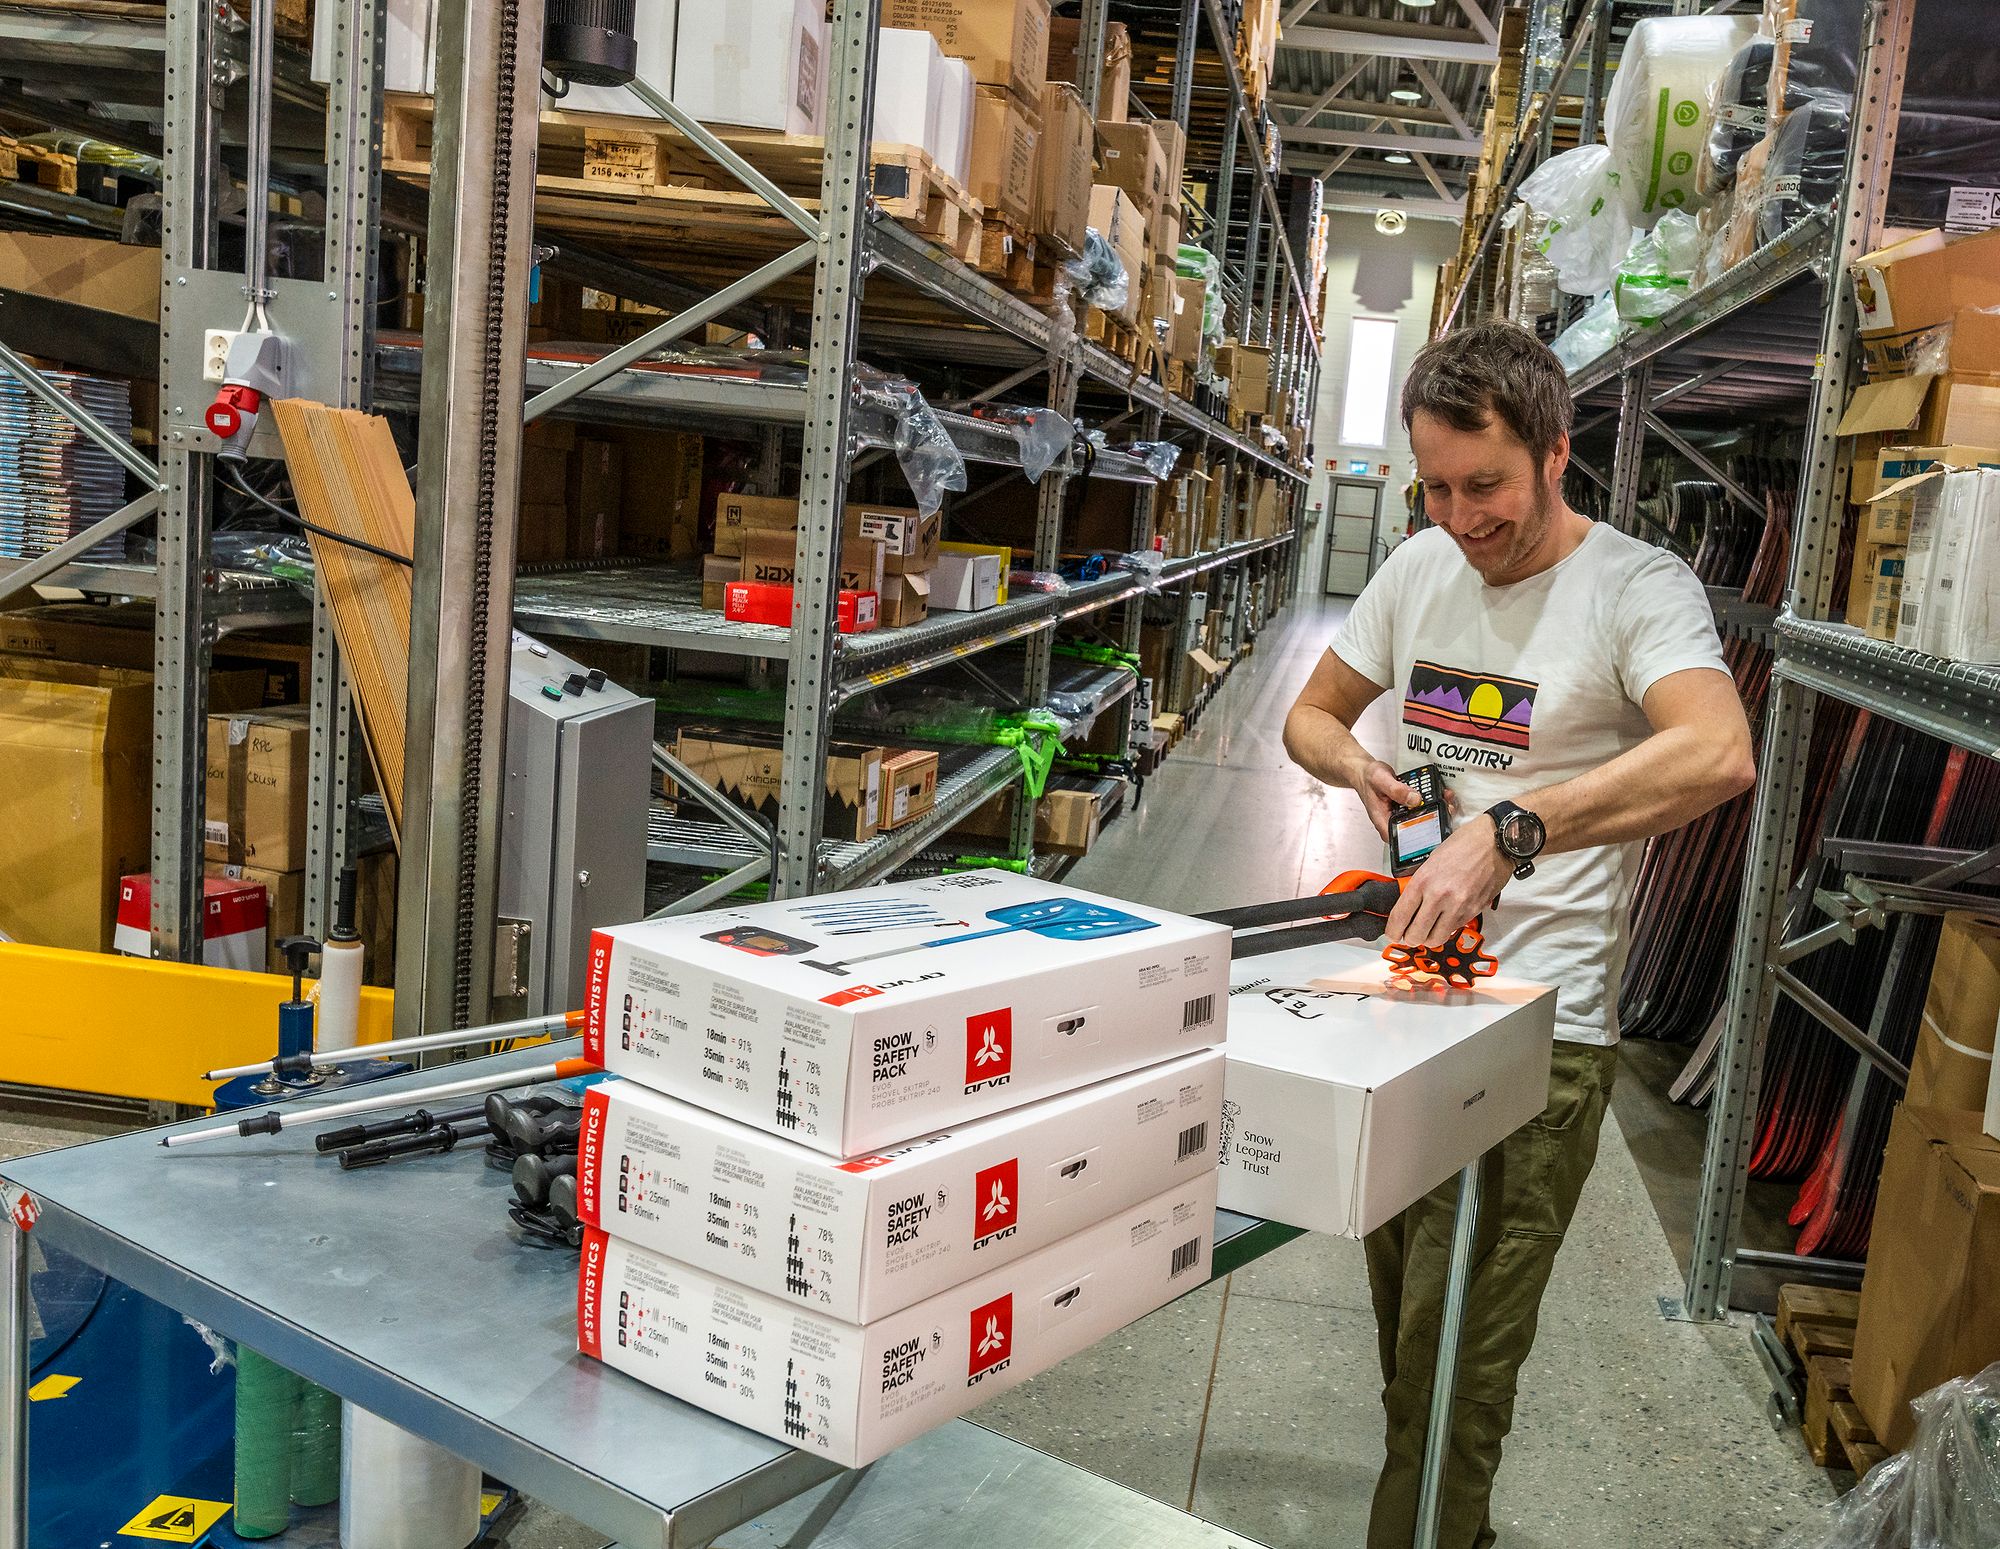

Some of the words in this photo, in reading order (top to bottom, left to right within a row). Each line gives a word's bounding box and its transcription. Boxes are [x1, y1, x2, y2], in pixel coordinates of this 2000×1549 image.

[591, 166, 612, 177] 2156
[1900, 462, 1922, 475] RAJA
[252, 737, 273, 752] RPC
[1407, 733, 1432, 754] WILD
[1436, 743, 1514, 770] COUNTRY
[588, 948, 605, 1036] STATISTICS
[650, 1028, 670, 1044] 25min
[706, 1028, 726, 1044] 18min
[738, 1038, 752, 1053] 91%
[874, 1031, 912, 1052] SNOW
[704, 1047, 724, 1064] 35min
[736, 1058, 750, 1073] 34%
[873, 1044, 920, 1067] SAFETY
[806, 1060, 820, 1076] 78%
[872, 1062, 906, 1082] PACK
[702, 1066, 724, 1083] 60min
[735, 1078, 749, 1092] 30%
[806, 1082, 820, 1096] 13%
[964, 1074, 1010, 1095] arva
[872, 1089, 900, 1102] SHOVEL
[872, 1098, 896, 1110] PROBE
[928, 1086, 941, 1096] 240
[808, 1102, 818, 1116] 7%
[806, 1122, 817, 1136] 2%
[1243, 1130, 1274, 1147] Snow
[584, 1107, 600, 1197] STATISTICS
[1236, 1143, 1280, 1163] Leopard
[1242, 1159, 1270, 1176] Trust
[668, 1177, 690, 1194] 11min
[650, 1190, 670, 1208] 25min
[709, 1192, 731, 1210] 18min
[743, 1203, 758, 1219] 91%
[888, 1193, 924, 1218] SNOW
[706, 1211, 730, 1229] 35min
[742, 1223, 757, 1239] 34%
[888, 1205, 932, 1232] SAFETY
[706, 1232, 728, 1248] 60min
[741, 1243, 756, 1259] 30%
[818, 1228, 834, 1244] 78%
[887, 1225, 918, 1248] PACK
[972, 1226, 1016, 1251] arva
[818, 1249, 834, 1264] 13%
[584, 1242, 600, 1330] STATISTICS
[820, 1270, 832, 1284] 7%
[820, 1290, 831, 1304] 2%
[668, 1316, 688, 1334] 11min
[648, 1327, 669, 1345] 25min
[708, 1332, 730, 1350] 18min
[742, 1346, 757, 1362] 91%
[884, 1336, 920, 1364] SNOW
[706, 1352, 728, 1370] 35min
[740, 1365, 756, 1381] 34%
[882, 1348, 926, 1378] SAFETY
[816, 1373, 832, 1390] 78%
[882, 1368, 914, 1394] PACK
[967, 1359, 1010, 1388] arva
[705, 1370, 727, 1388] 60min
[740, 1384, 754, 1400] 30%
[816, 1394, 830, 1410] 13%
[818, 1414, 830, 1428] 7%
[818, 1434, 829, 1448] 2%
